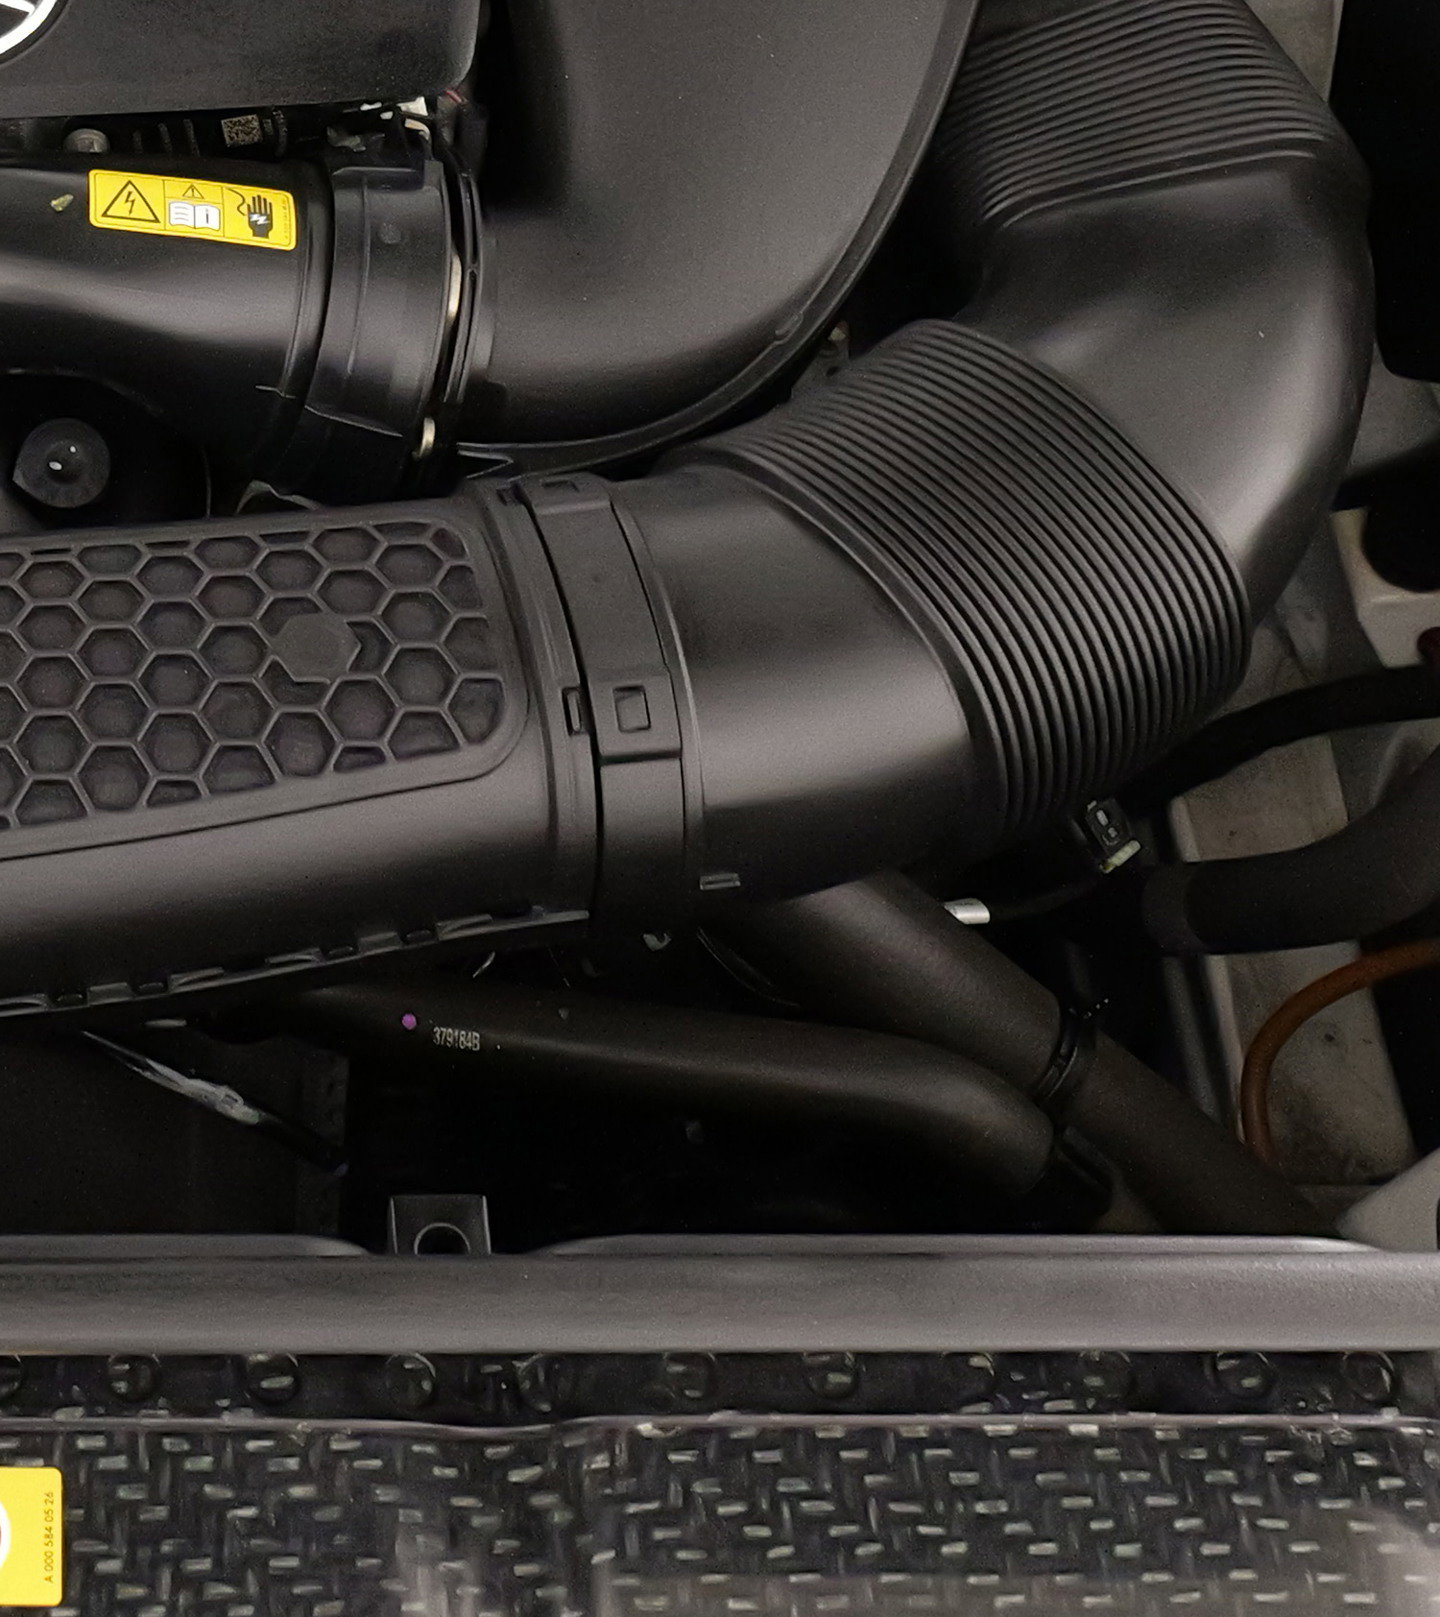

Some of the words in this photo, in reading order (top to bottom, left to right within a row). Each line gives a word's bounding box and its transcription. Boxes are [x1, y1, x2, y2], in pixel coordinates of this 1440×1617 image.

[433, 1026, 481, 1052] 379184B
[44, 1509, 54, 1523] 05
[44, 1526, 54, 1547] 584
[44, 1550, 54, 1572] 000
